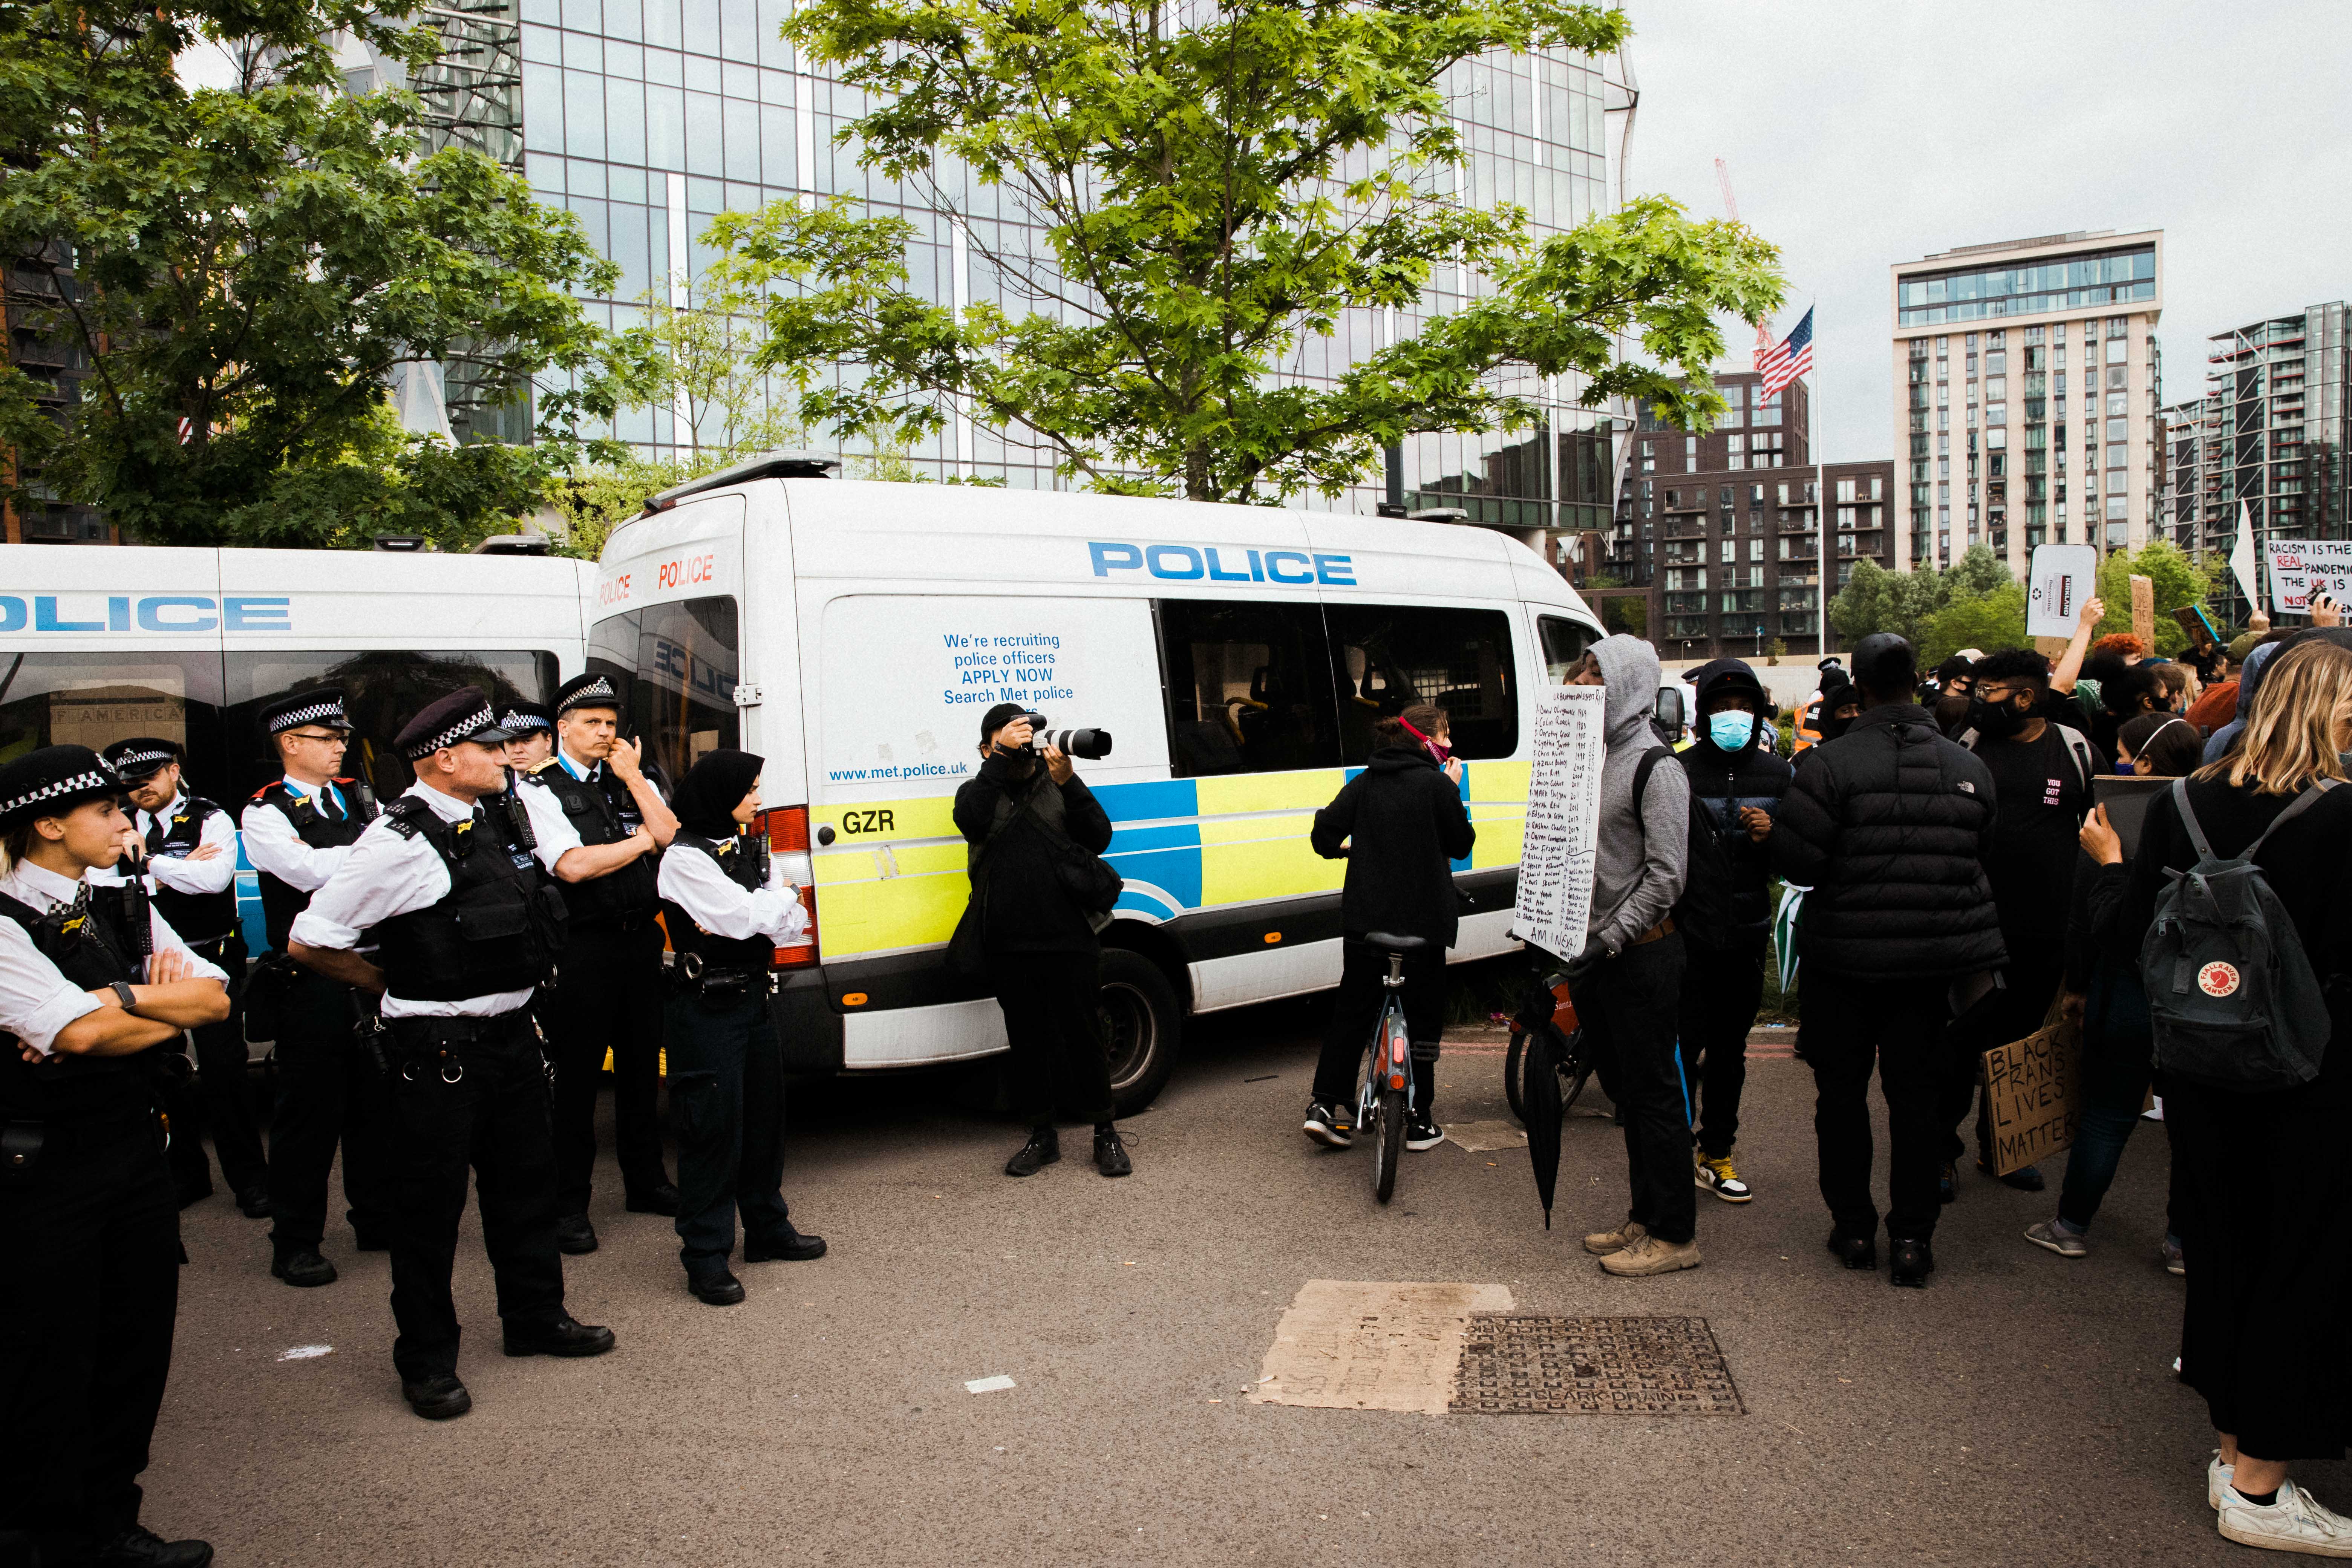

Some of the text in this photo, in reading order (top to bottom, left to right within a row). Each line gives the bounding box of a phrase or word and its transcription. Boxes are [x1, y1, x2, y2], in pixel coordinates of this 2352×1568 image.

[2269, 543, 2351, 554] RACISM IS THE
[1088, 542, 1357, 585] POLICE
[2277, 556, 2304, 567] REAL
[658, 554, 713, 589] POLICE
[599, 574, 631, 608] POLICE
[2281, 577, 2305, 587] THE
[2334, 579, 2345, 590] IS
[2285, 596, 2306, 605] NOT
[944, 633, 1060, 649] We're recruiting
[954, 651, 1055, 669] police officers
[962, 668, 1052, 684] APPLY NOW
[944, 686, 1073, 704] Search Met police
[1596, 689, 1604, 705] RIP
[80, 707, 180, 722] AMERICA
[1578, 709, 1586, 718] 1969
[1556, 716, 1570, 726] Roach
[1577, 721, 1586, 730] 1983
[1539, 729, 1557, 739] Dorothy
[830, 762, 968, 780] www.met.police.uk
[1550, 769, 1560, 777] Rigg
[2043, 796, 2059, 805] THIS
[843, 809, 895, 834] GZR
[1531, 810, 1545, 819] Edson
[1551, 824, 1566, 832] Charles
[1530, 927, 1546, 943] AM
[1990, 1029, 2064, 1076] BLACK
[1991, 1051, 2066, 1098] TRANS
[1997, 1076, 2065, 1127] LIVES
[1999, 1112, 2074, 1168] MATTER
